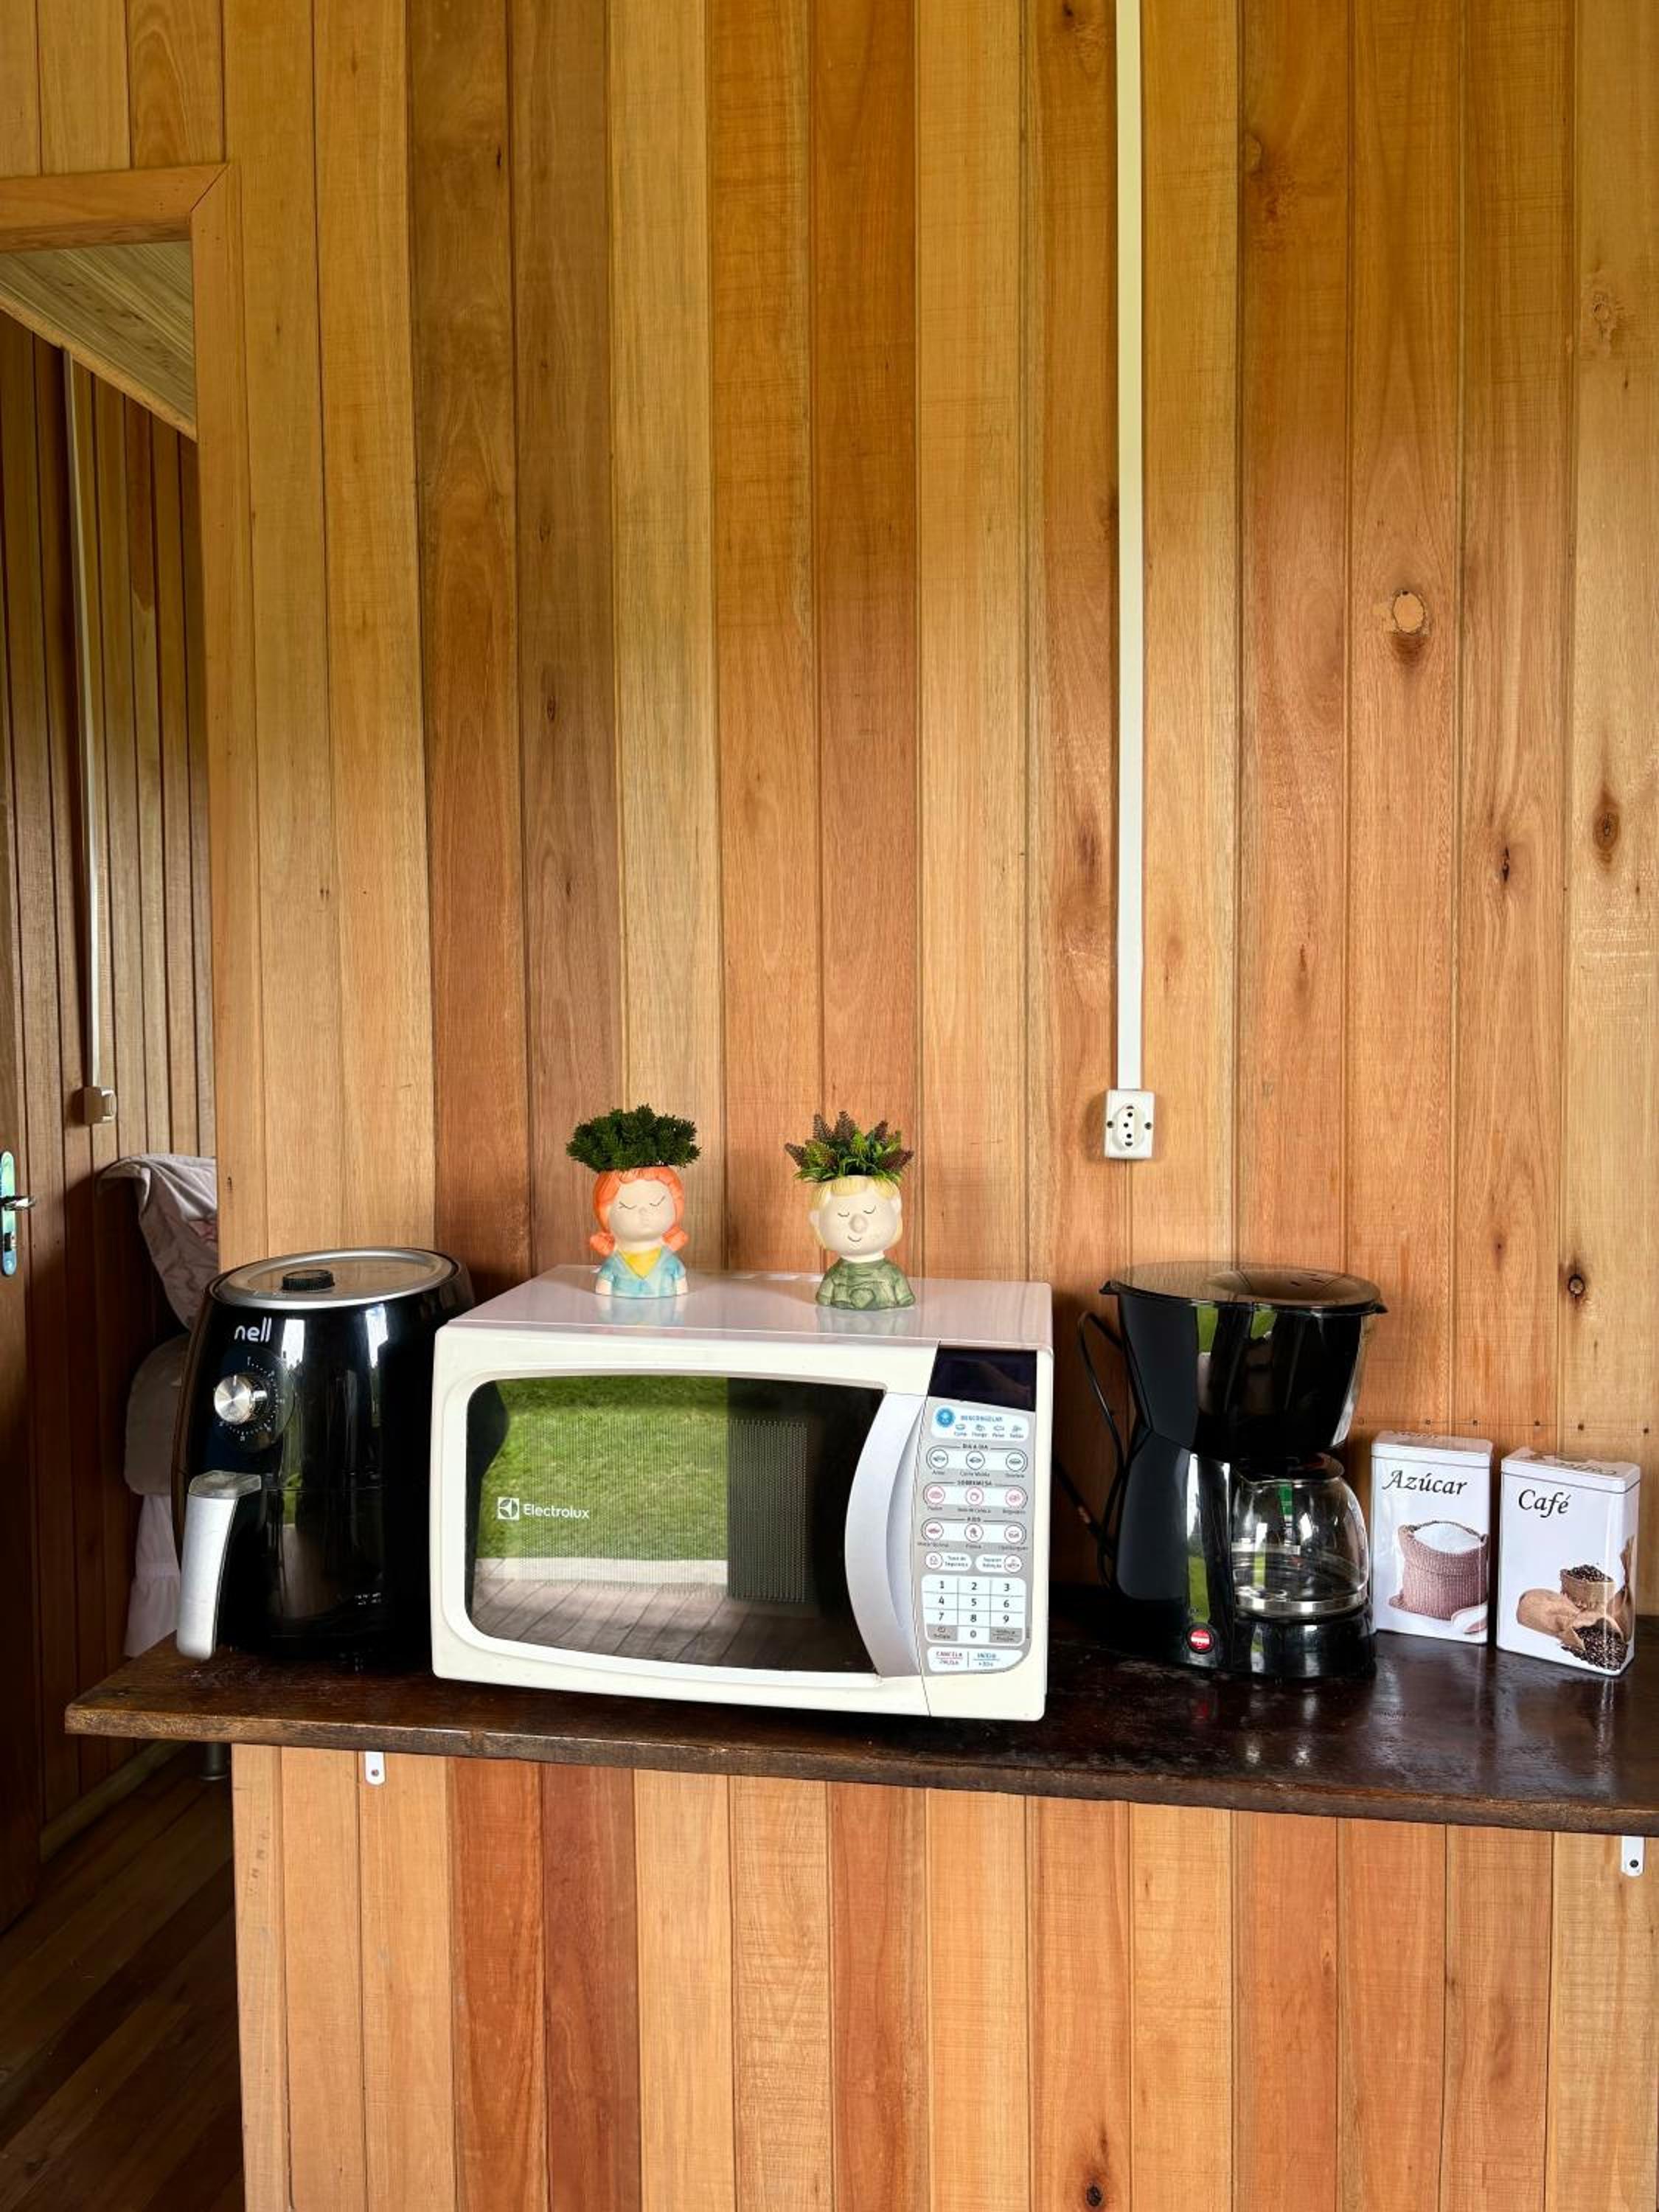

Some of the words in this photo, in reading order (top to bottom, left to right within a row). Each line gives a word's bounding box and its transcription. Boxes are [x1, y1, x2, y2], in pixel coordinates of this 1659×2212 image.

[234, 1316, 272, 1343] nell
[1382, 1470, 1467, 1495] Azúcar
[1518, 1487, 1572, 1518] Café
[524, 1503, 590, 1519] Electrolux
[939, 1580, 945, 1589] 1
[971, 1582, 978, 1590] 2
[1004, 1583, 1010, 1592] 3
[938, 1596, 945, 1605] 4
[971, 1598, 977, 1607] 5
[1003, 1599, 1010, 1608] 6
[939, 1612, 945, 1621] 7
[970, 1614, 977, 1623] 8
[1003, 1615, 1009, 1624] 9
[970, 1630, 977, 1638] 0
